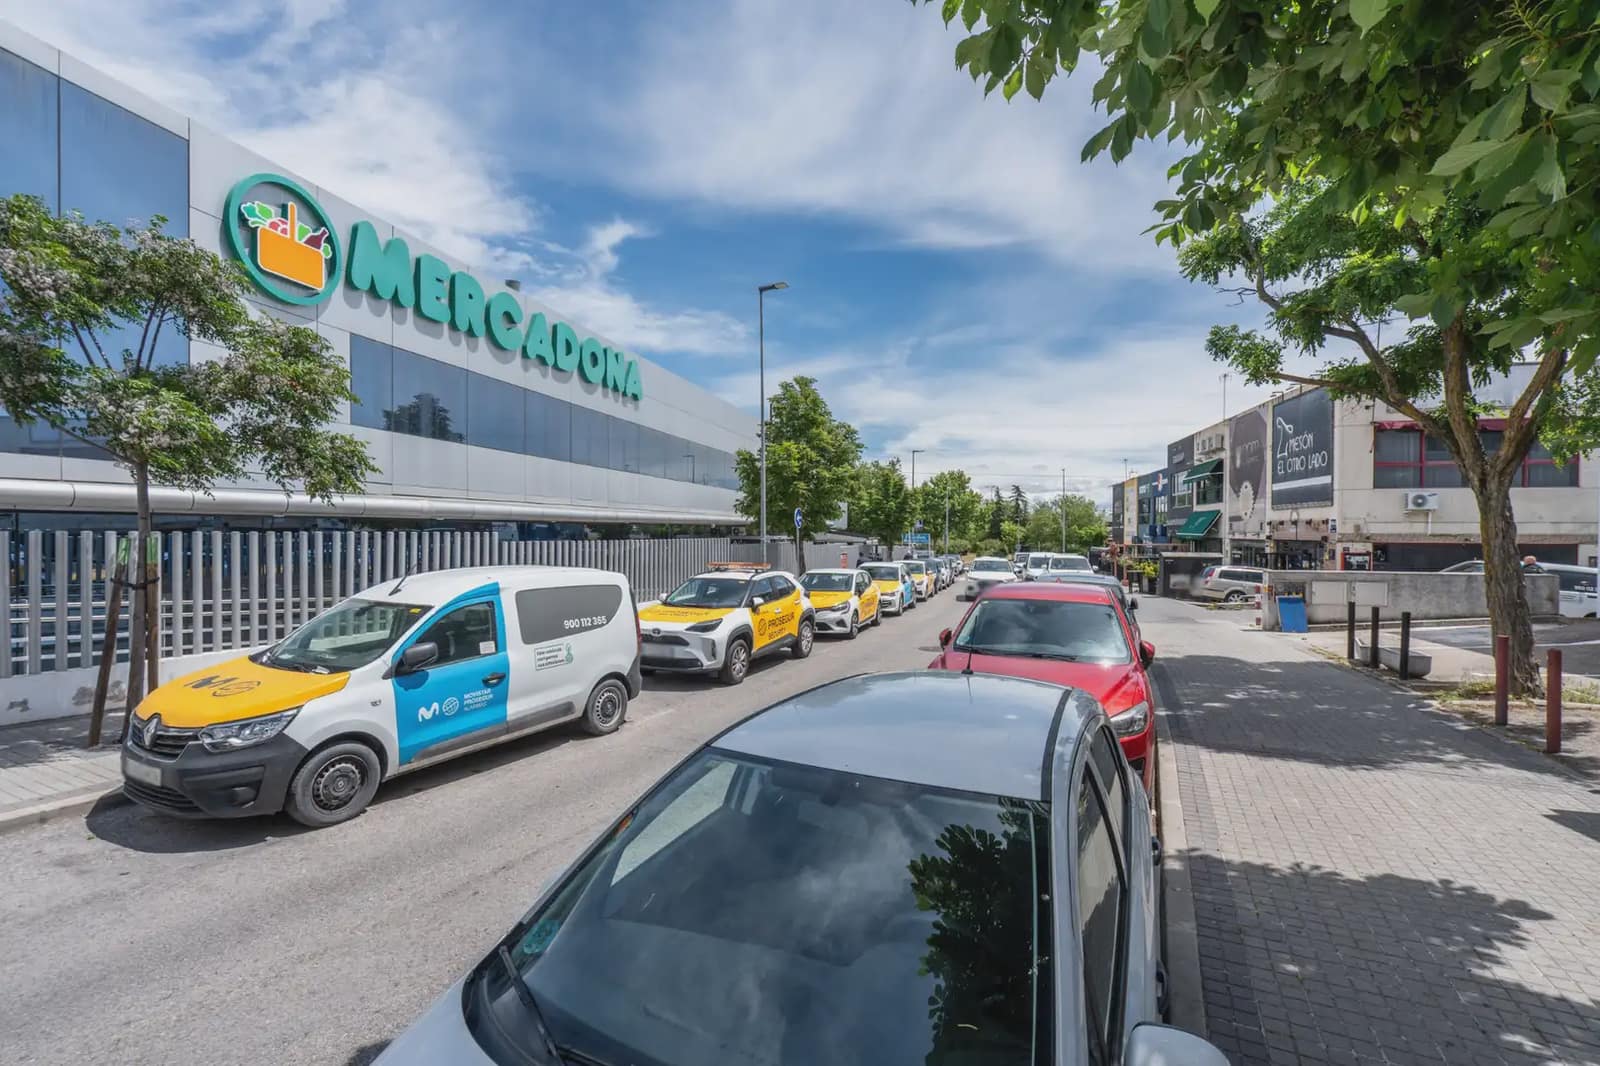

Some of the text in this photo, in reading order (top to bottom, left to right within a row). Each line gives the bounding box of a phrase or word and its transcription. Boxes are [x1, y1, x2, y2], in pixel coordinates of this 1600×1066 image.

[345, 220, 642, 401] MERCADONA
[1288, 430, 1314, 452] MESÓN
[1277, 450, 1328, 474] EL OTRO LADO
[563, 619, 579, 629] 900
[580, 616, 592, 627] 112
[768, 611, 795, 630] PROSEGUR
